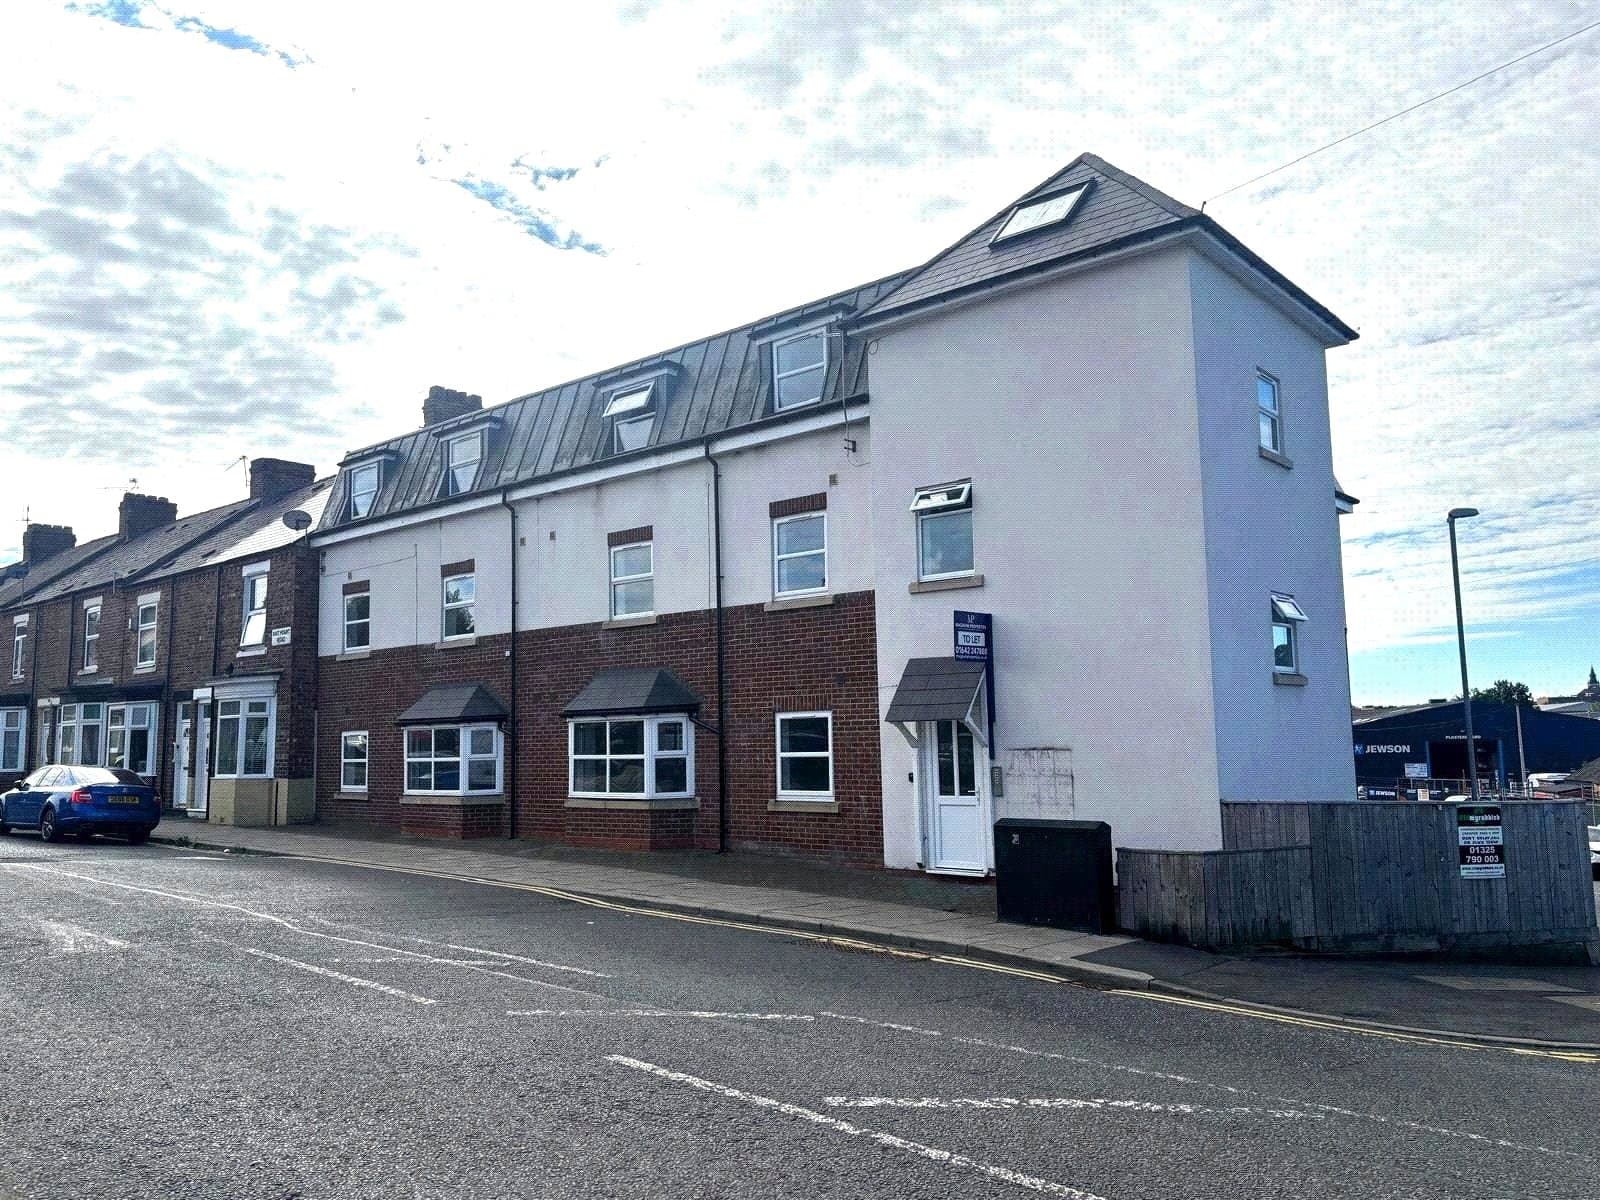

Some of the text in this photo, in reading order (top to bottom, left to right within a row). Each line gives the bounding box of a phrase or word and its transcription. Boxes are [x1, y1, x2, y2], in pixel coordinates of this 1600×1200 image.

[962, 634, 981, 644] TO LET
[1365, 744, 1411, 753] JEWSON
[1469, 846, 1496, 854] 01325
[1465, 855, 1499, 863] 790 003
